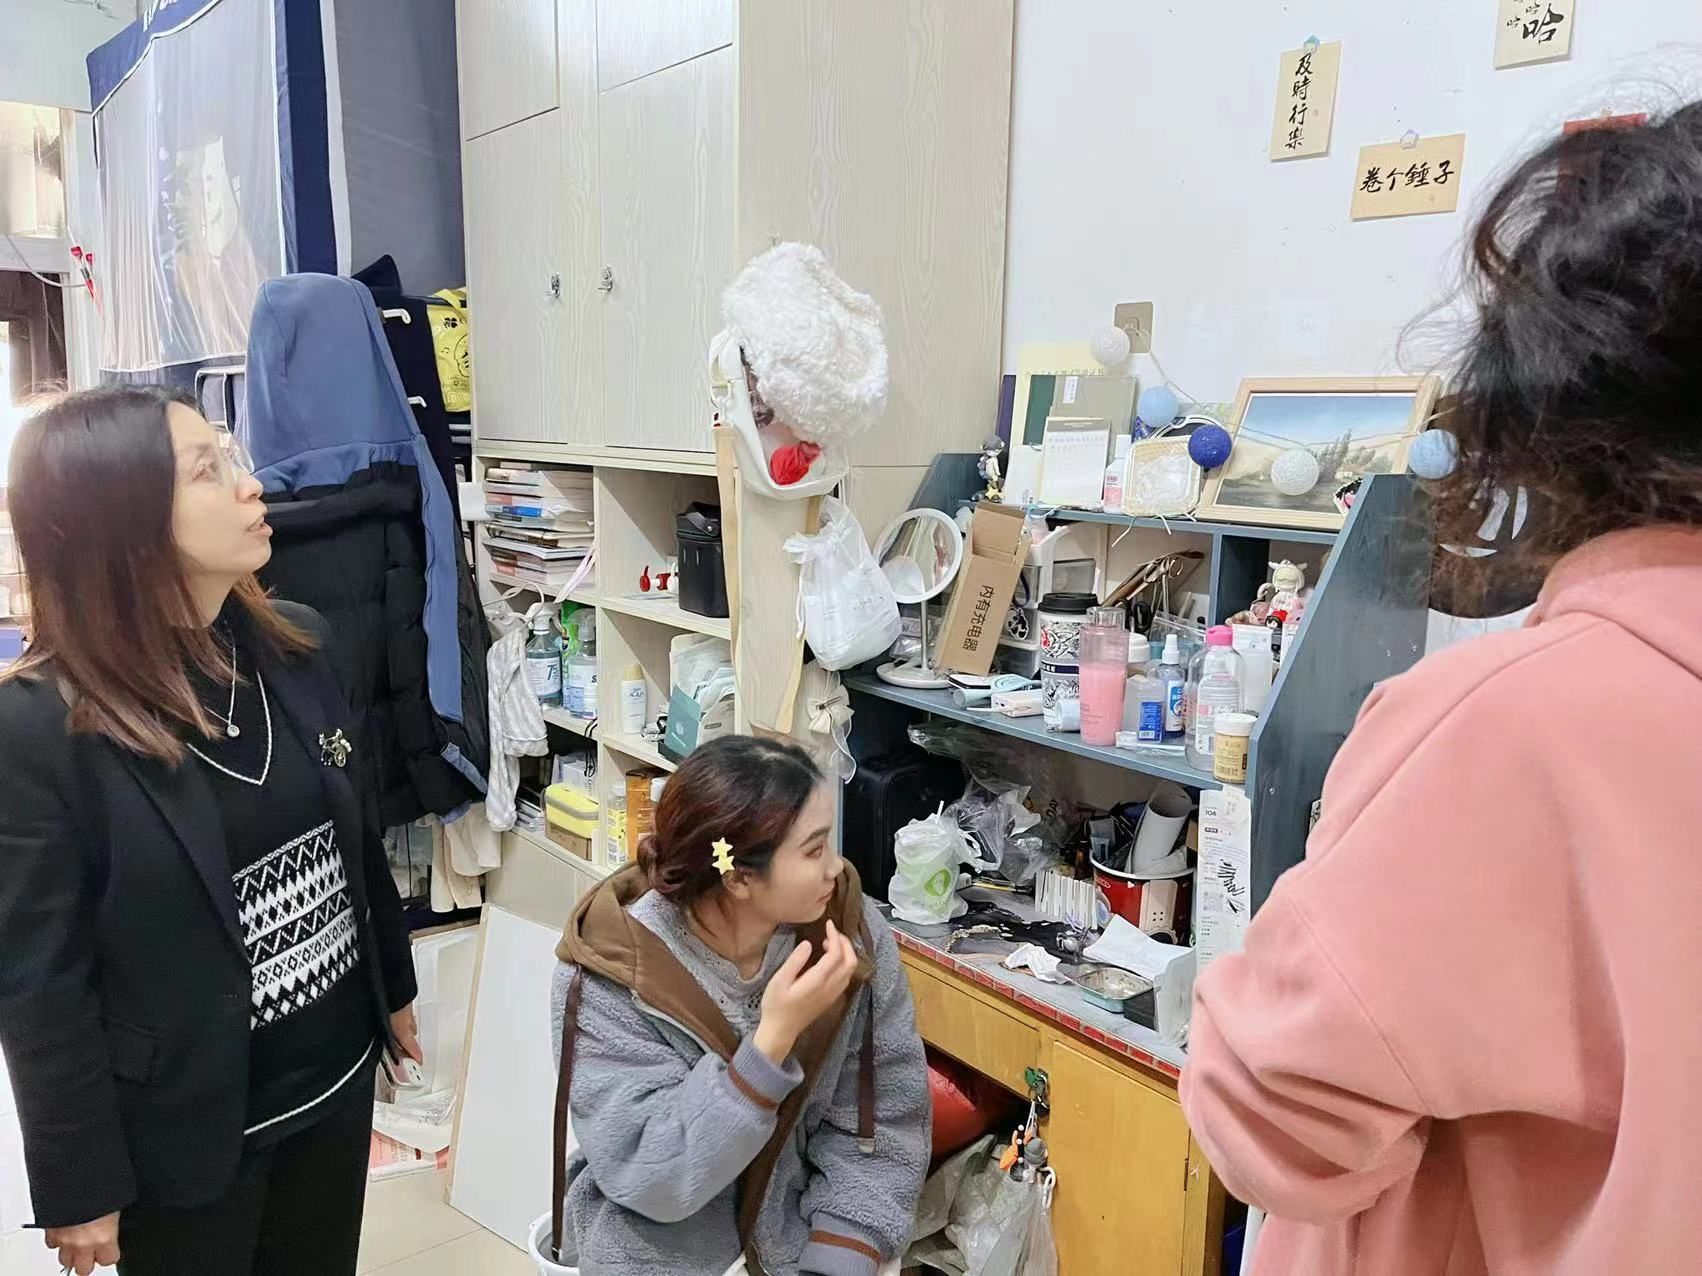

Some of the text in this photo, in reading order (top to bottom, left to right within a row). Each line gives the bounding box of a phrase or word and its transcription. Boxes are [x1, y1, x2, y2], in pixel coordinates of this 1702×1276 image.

[1522, 2, 1564, 44] 哈
[962, 584, 995, 652] 内有充电器
[1205, 809, 1217, 817] 106
